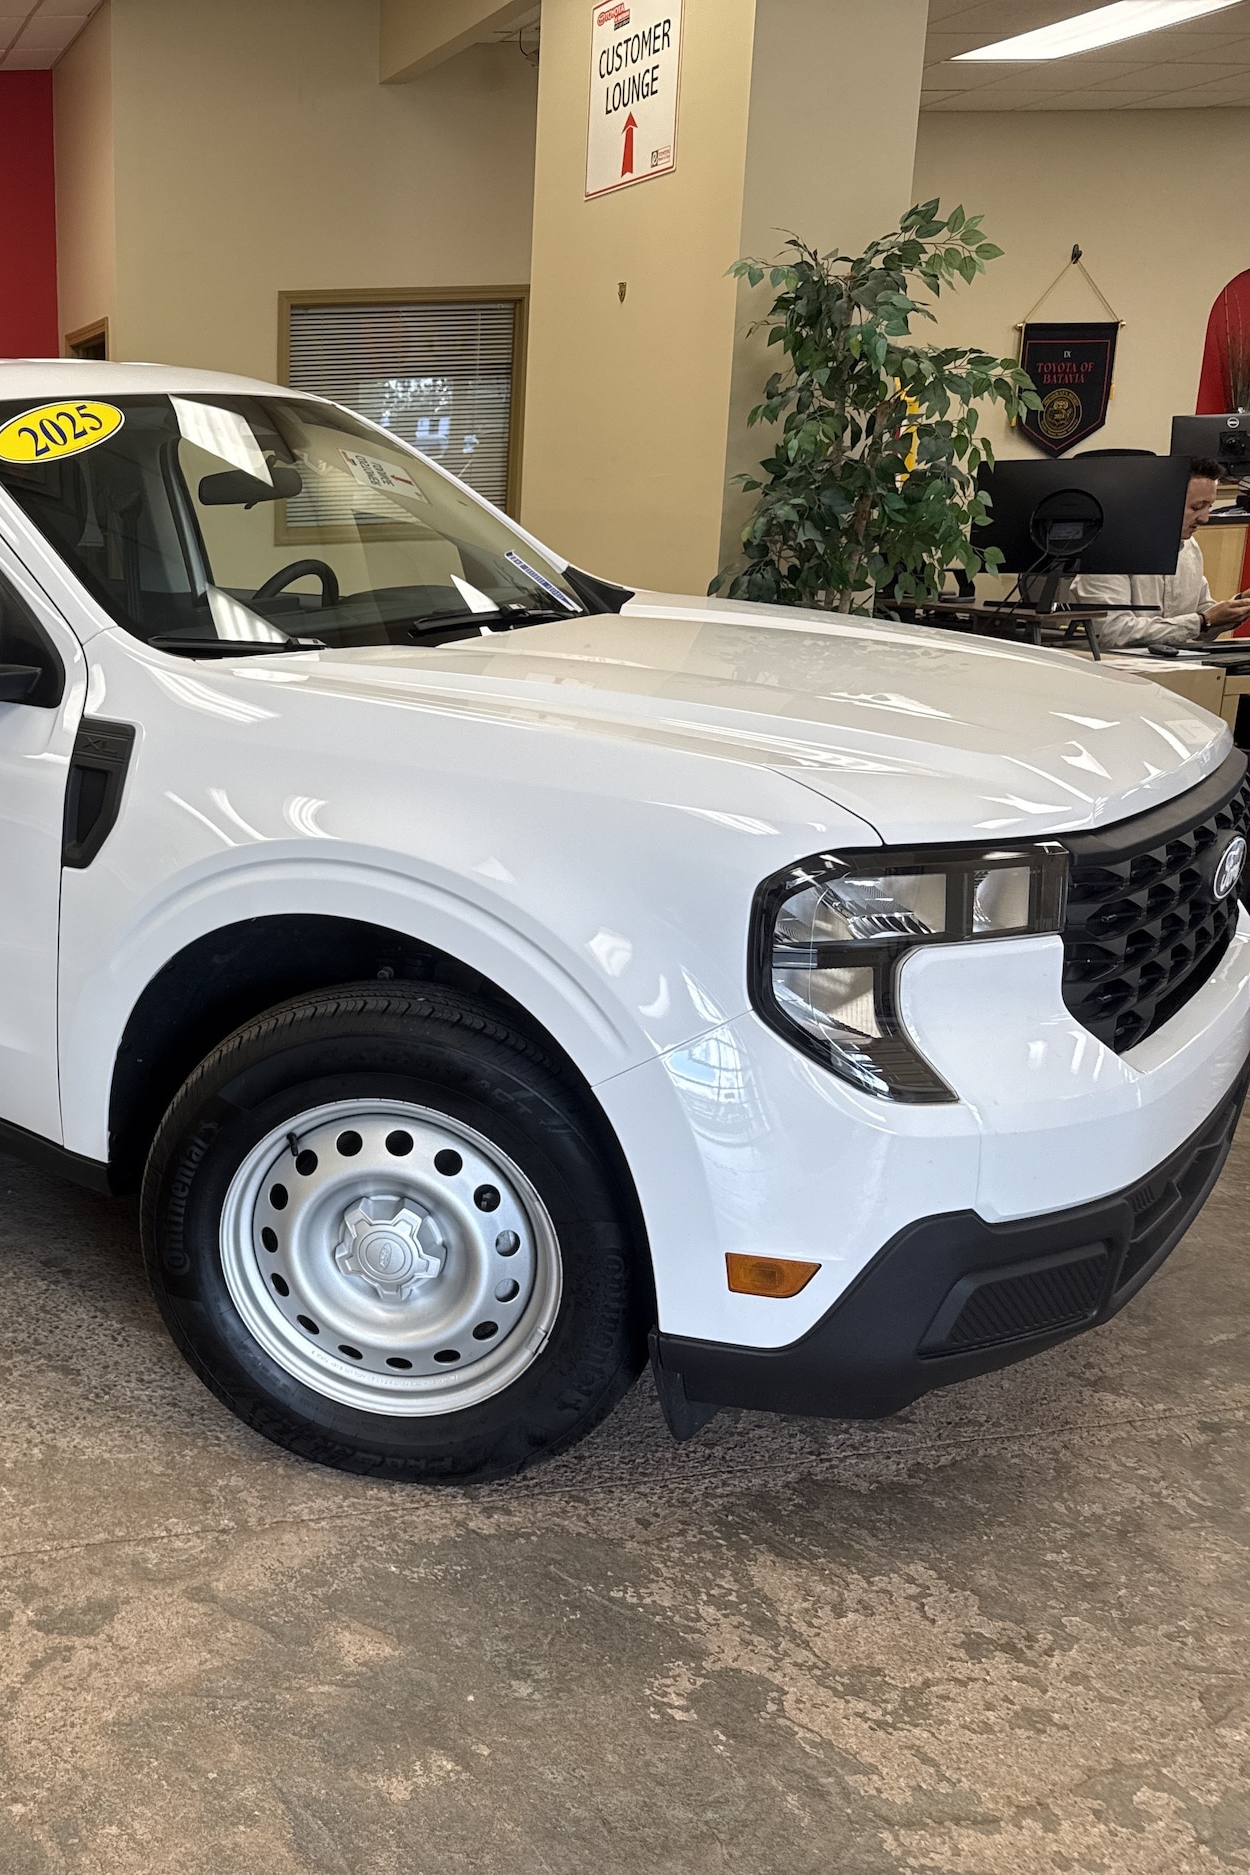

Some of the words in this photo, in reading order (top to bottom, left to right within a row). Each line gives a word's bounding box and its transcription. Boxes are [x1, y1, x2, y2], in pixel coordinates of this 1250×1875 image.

[599, 19, 672, 79] CUSTOMER
[605, 65, 660, 115] LOUNGE
[1037, 362, 1077, 373] TOYOTA
[1080, 362, 1095, 372] OF
[1042, 373, 1086, 384] BATAVIA
[17, 404, 103, 457] 2025
[82, 735, 119, 754] XL
[164, 1134, 207, 1276] Continental
